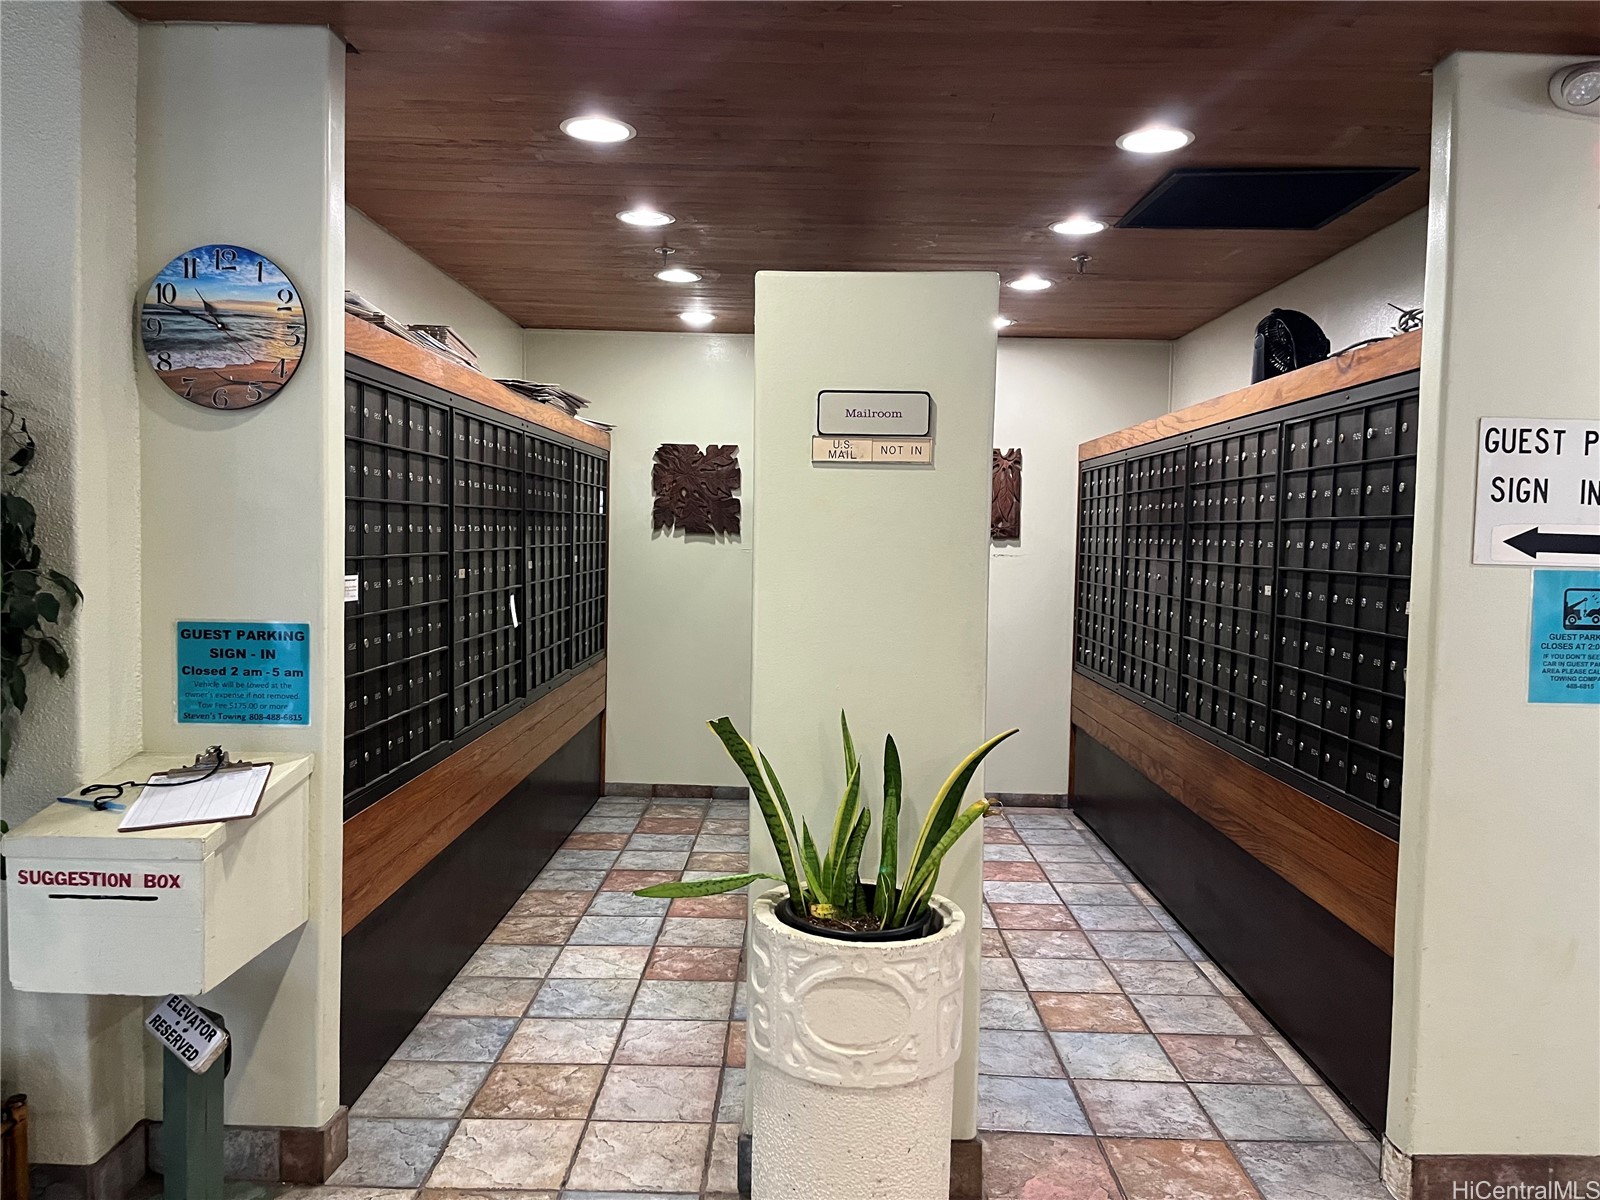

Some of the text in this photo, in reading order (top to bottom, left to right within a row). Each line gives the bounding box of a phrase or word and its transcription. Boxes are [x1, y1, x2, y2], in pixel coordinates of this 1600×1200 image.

[184, 258, 198, 278] 11
[214, 248, 238, 270] 12
[256, 261, 263, 282] 1
[155, 282, 177, 304] 10
[277, 289, 293, 312] 2
[146, 318, 162, 337] 9
[284, 324, 300, 346] 3
[156, 352, 172, 371] 8
[271, 358, 288, 378] 4
[182, 377, 196, 396] 7
[246, 381, 262, 402] 5
[212, 387, 229, 408] 6
[845, 408, 902, 418] Mailroom
[833, 440, 852, 449] U.S.
[880, 446, 922, 455] NOT IN
[1485, 428, 1566, 455] GUEST
[828, 450, 857, 459] MAIL
[1490, 476, 1600, 506] SIGN IN
[181, 629, 304, 641] GUEST PARKING
[210, 648, 246, 658] SIGN
[261, 650, 276, 659] IN
[182, 666, 226, 676] Closed
[230, 666, 238, 676] 2
[243, 668, 262, 676] am
[272, 668, 280, 676] 5
[284, 669, 304, 677] am
[218, 713, 246, 722] Towing
[18, 870, 181, 888] SUGGESTION BOX
[166, 995, 218, 1043] ELEVATOR
[149, 1014, 199, 1062] RESERVED
